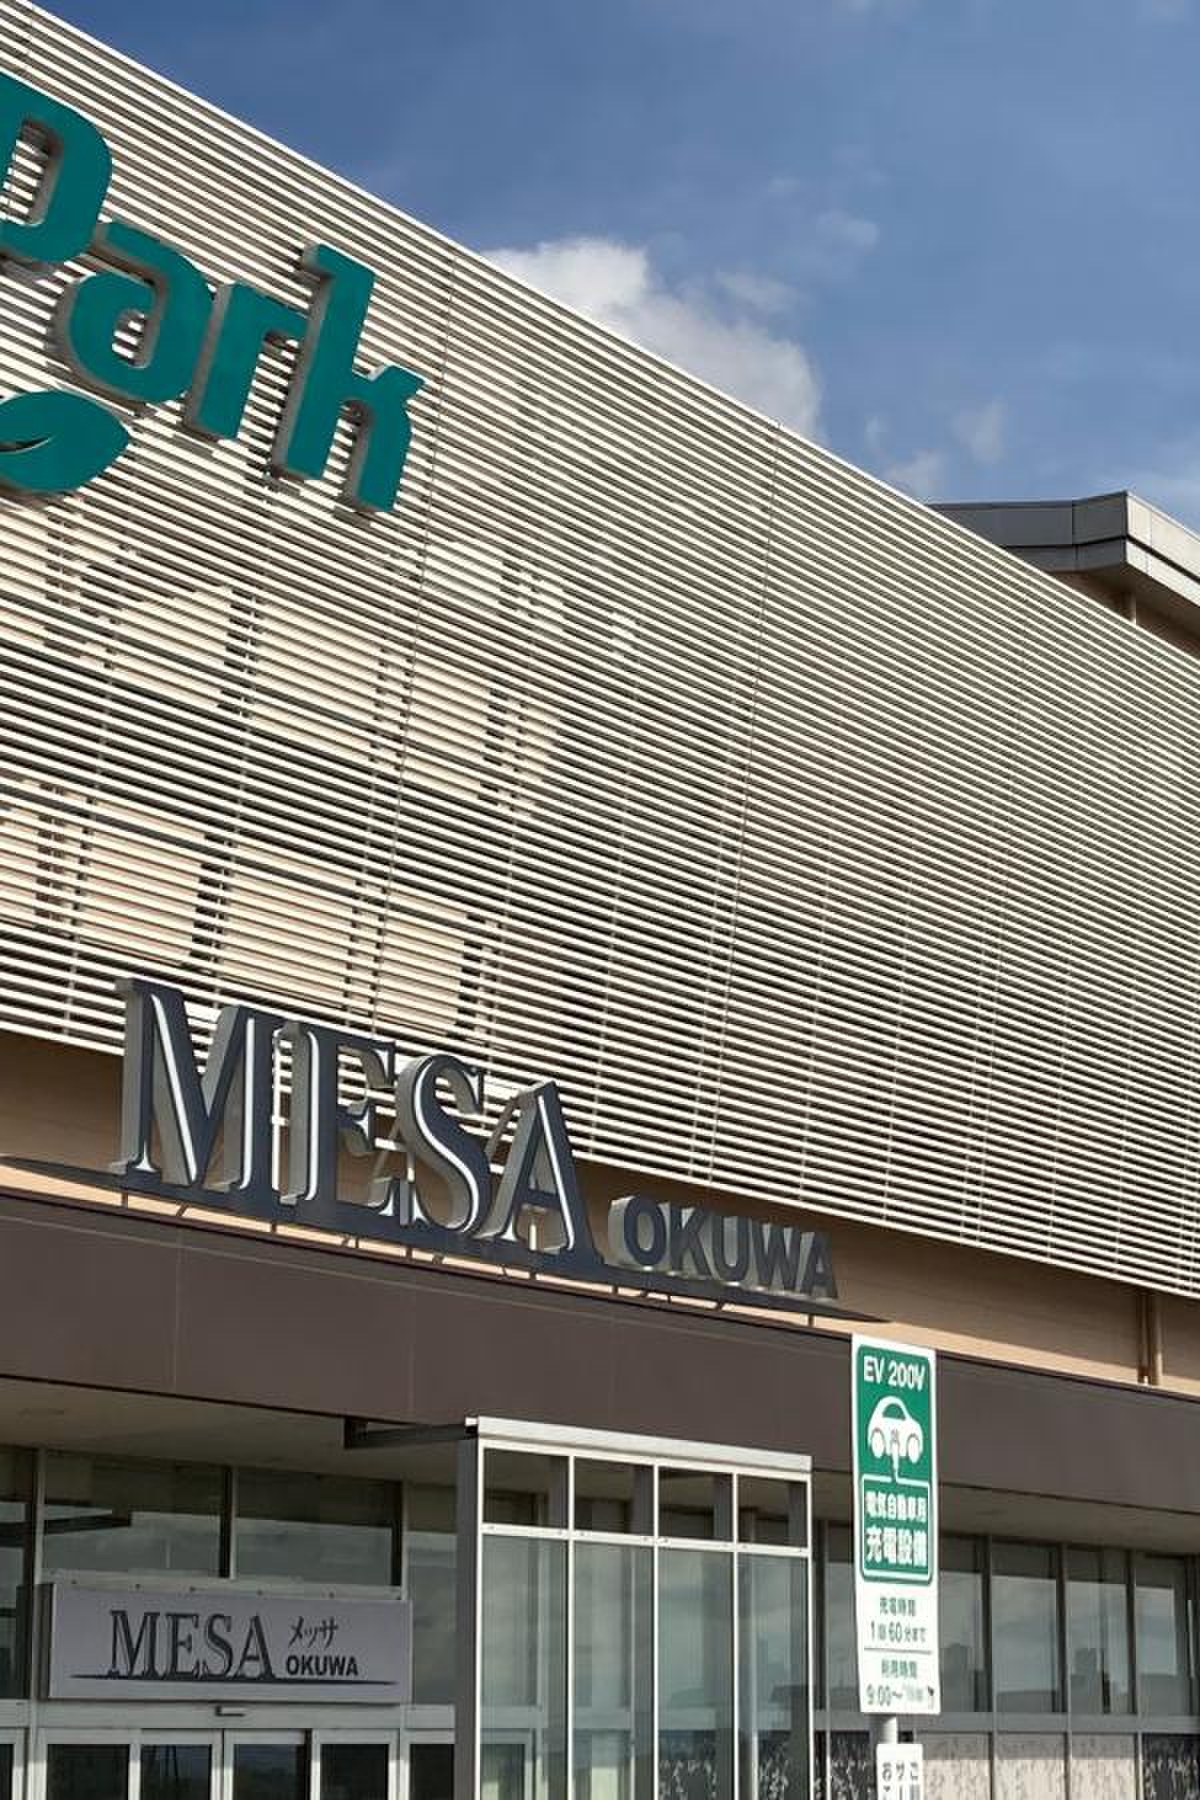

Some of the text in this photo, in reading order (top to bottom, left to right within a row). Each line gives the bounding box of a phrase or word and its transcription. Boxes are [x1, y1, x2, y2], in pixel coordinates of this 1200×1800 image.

[111, 977, 839, 1299] MESA OKUWA
[863, 1355, 926, 1391] EV 200V
[865, 1525, 927, 1568] 充電設備
[106, 1610, 275, 1679] MESA
[288, 1616, 338, 1648] メッサ
[286, 1654, 358, 1677] OKUWA
